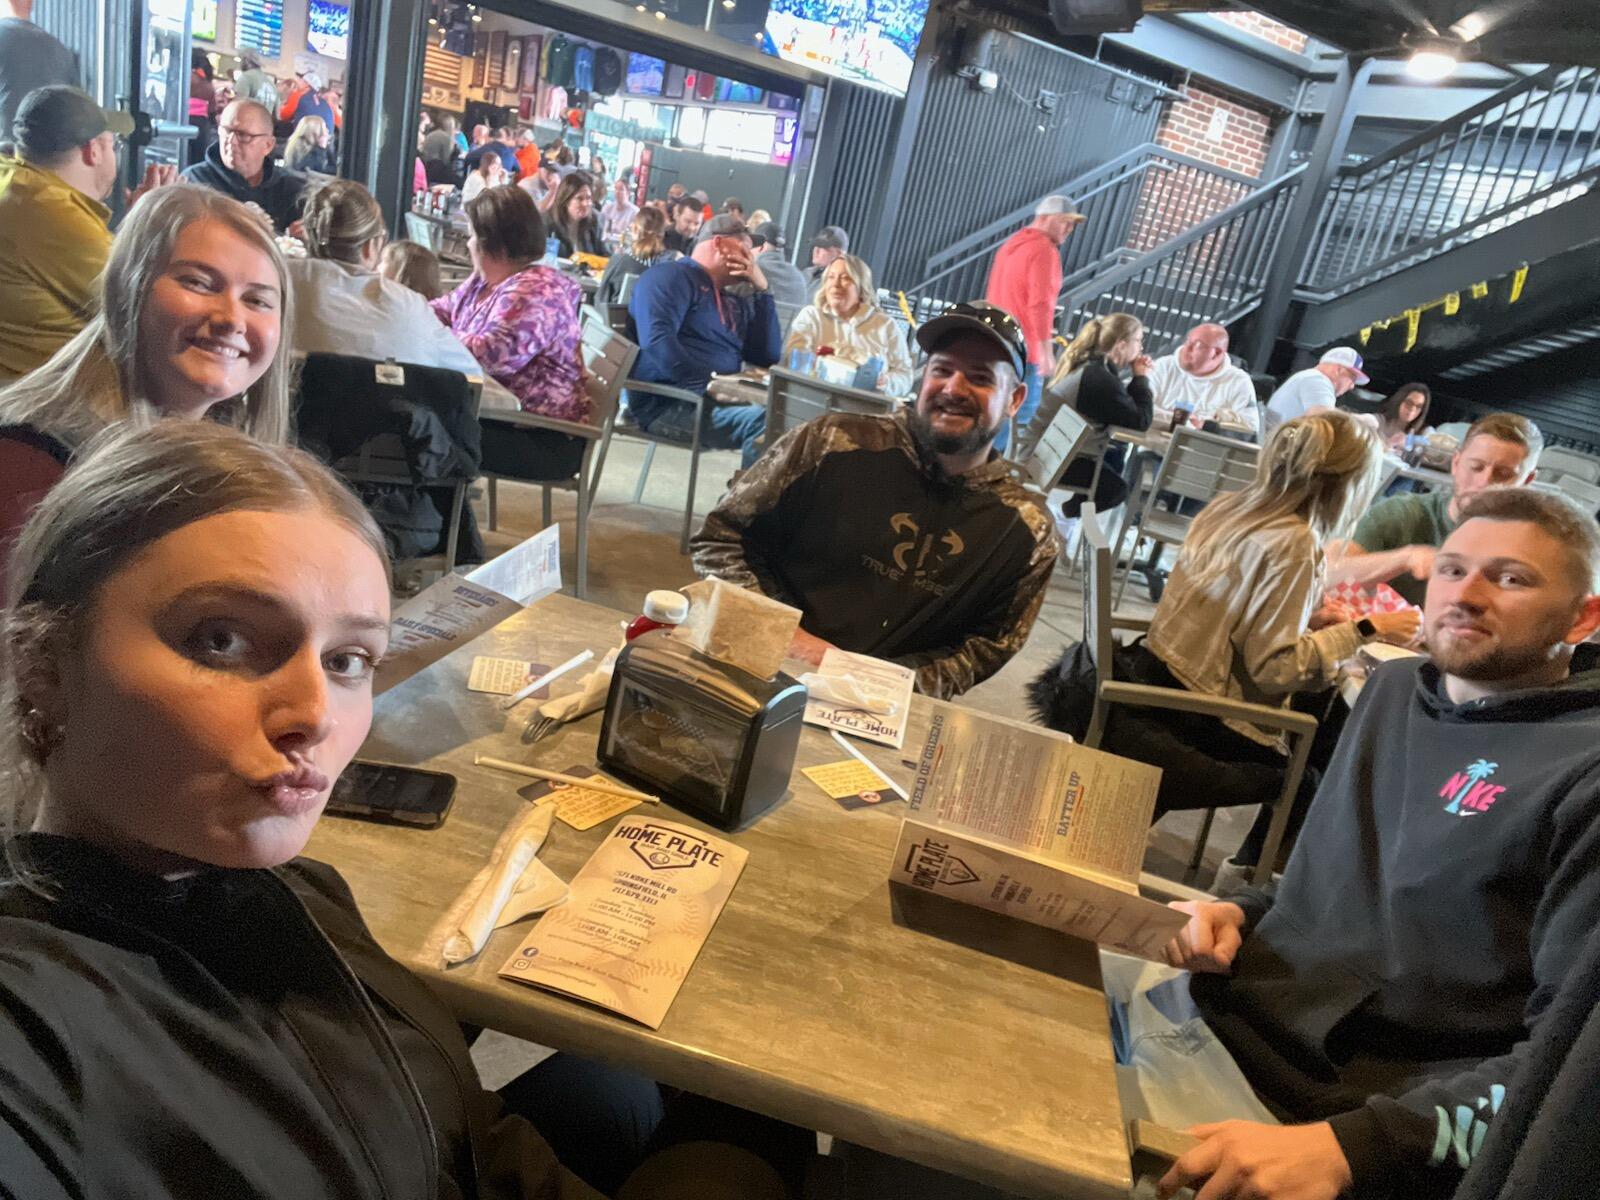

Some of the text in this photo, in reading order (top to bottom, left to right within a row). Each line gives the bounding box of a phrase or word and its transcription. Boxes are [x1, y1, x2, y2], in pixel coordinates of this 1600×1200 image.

[816, 710, 898, 738] HOME PLATE
[910, 714, 944, 811] FIELD OF GREENS
[1057, 771, 1081, 837] BATTER UP
[1439, 760, 1506, 813] NIKE
[614, 825, 725, 868] HOME PLATE
[918, 838, 949, 868] PLATE
[911, 863, 940, 891] HOME
